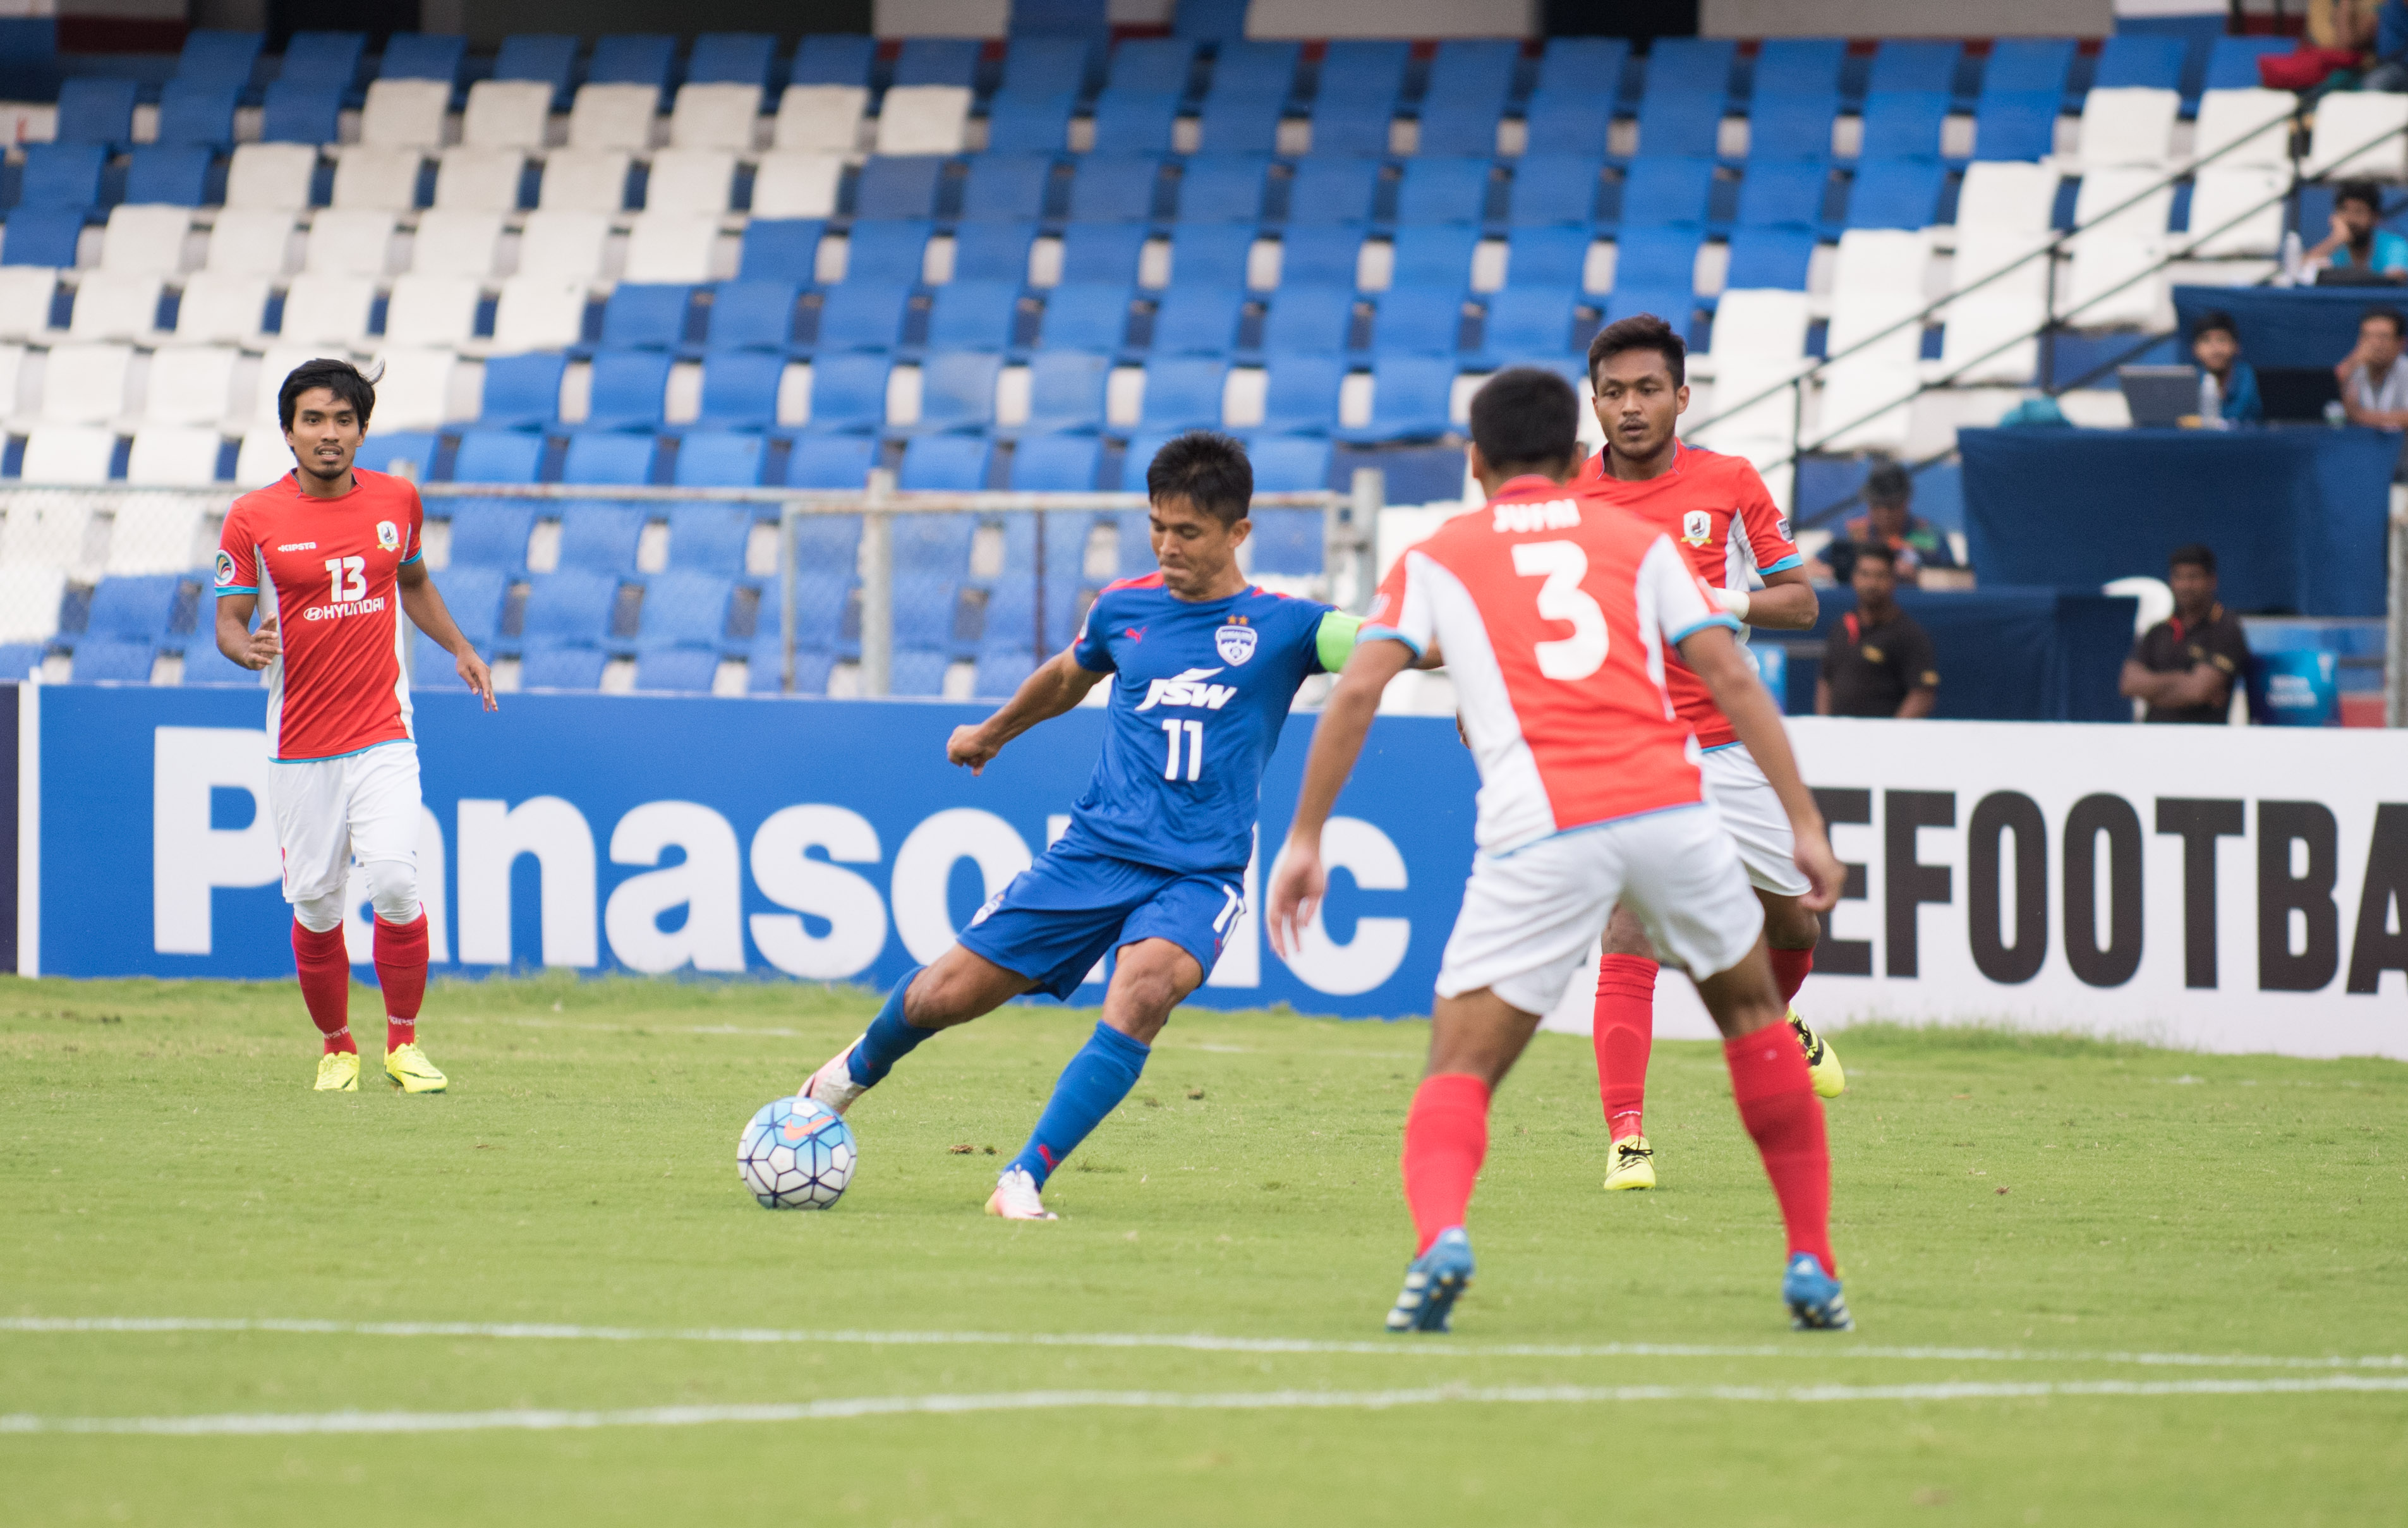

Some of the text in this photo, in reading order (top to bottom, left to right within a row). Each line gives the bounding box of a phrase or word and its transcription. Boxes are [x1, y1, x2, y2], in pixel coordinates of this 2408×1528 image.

[325, 555, 367, 603] 13
[324, 597, 384, 619] HYUNDAI
[1511, 540, 1609, 680] 3
[1135, 678, 1238, 711] JSW
[1161, 719, 1203, 782] 11
